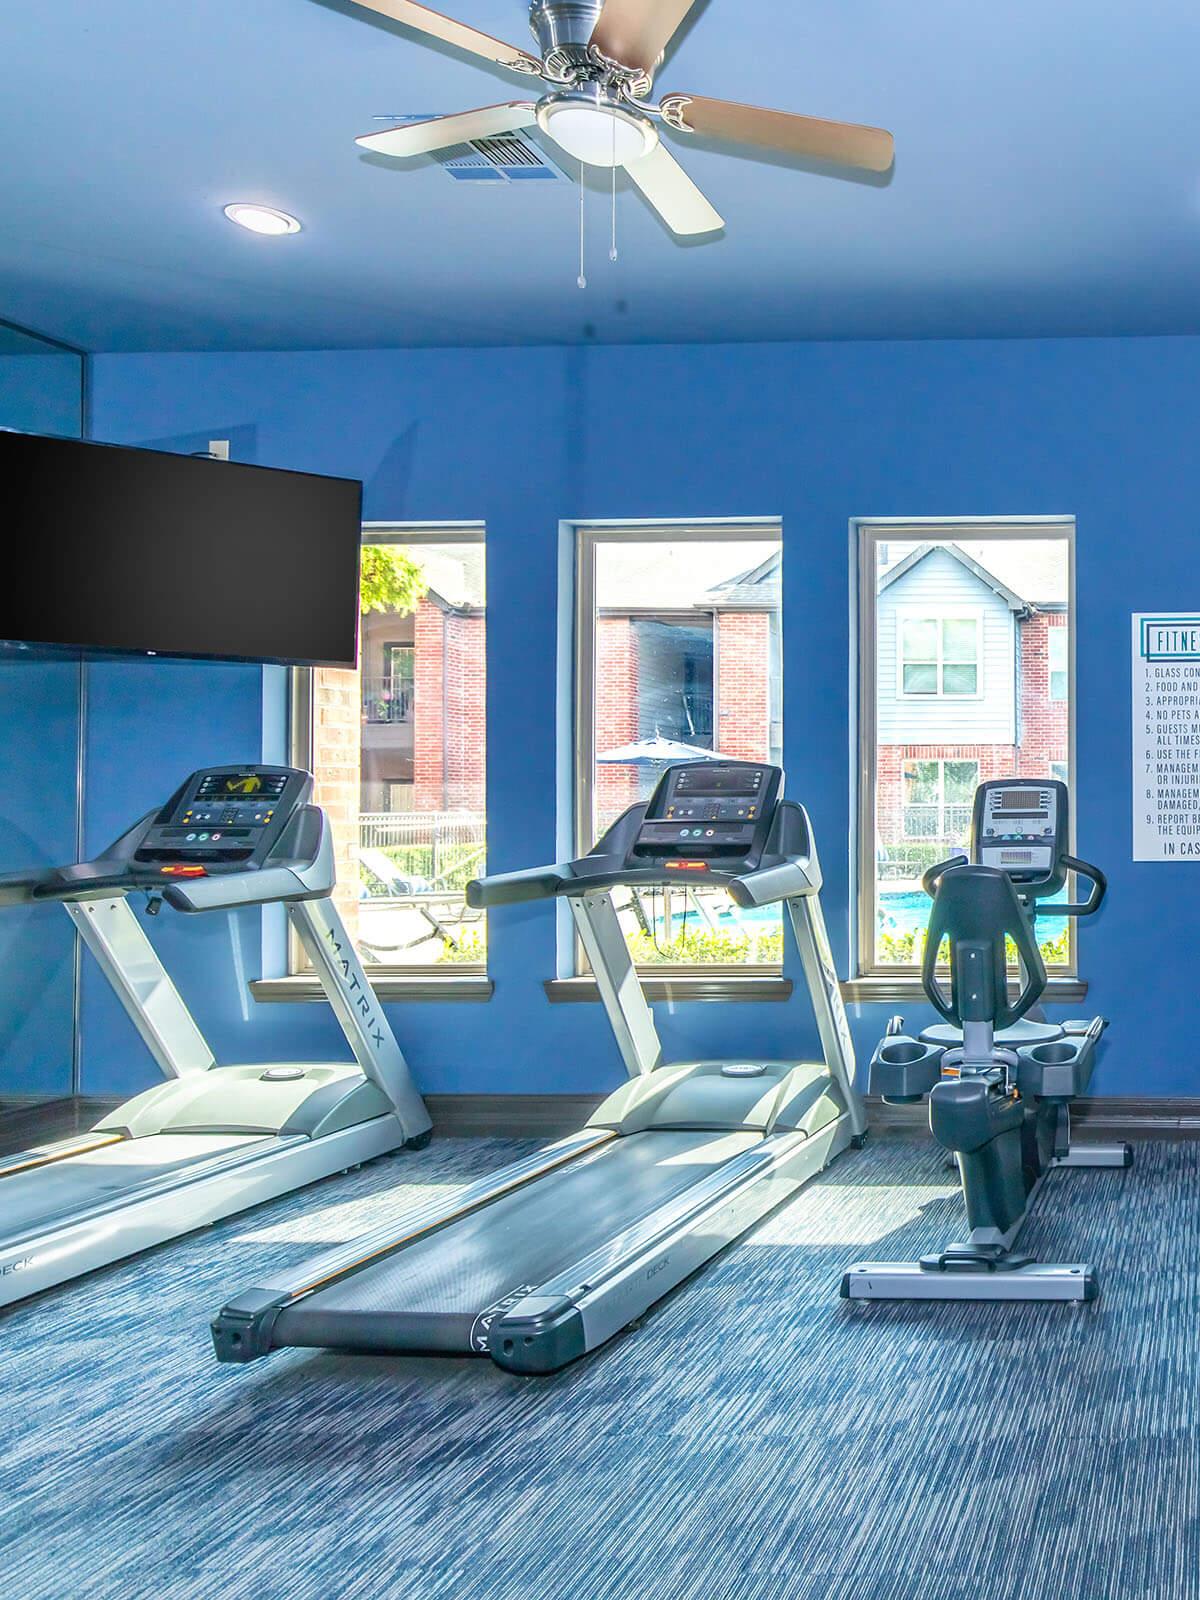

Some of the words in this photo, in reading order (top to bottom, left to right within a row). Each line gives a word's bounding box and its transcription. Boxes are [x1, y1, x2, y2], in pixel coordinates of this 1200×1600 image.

[1146, 669, 1152, 678] 1.
[1155, 668, 1181, 678] GLASS
[1146, 683, 1152, 692] 2.
[1157, 682, 1178, 692] FOOD
[1181, 682, 1198, 691] AND
[1146, 697, 1153, 705] 3.
[1146, 711, 1153, 719] 4.
[1157, 711, 1168, 719] NO
[1171, 710, 1191, 719] PETS
[1146, 725, 1153, 734] 5.
[1157, 725, 1188, 733] GUESTS
[1157, 736, 1172, 744] ALL
[1146, 750, 1154, 759] 6.
[1157, 750, 1173, 759] USE
[1176, 750, 1190, 758] THE
[1146, 765, 1153, 773] 7.
[1158, 776, 1168, 784] OR
[1146, 789, 1154, 798] 8.
[1158, 800, 1200, 810] DAMAGED,
[1146, 815, 1154, 823] 9.
[1158, 814, 1189, 823] REPORT
[1158, 826, 1173, 835] THE
[1164, 843, 1175, 855] IN
[325, 927, 385, 1048] MATRIX
[0, 1255, 33, 1276] ECK
[646, 1256, 670, 1280] DECK
